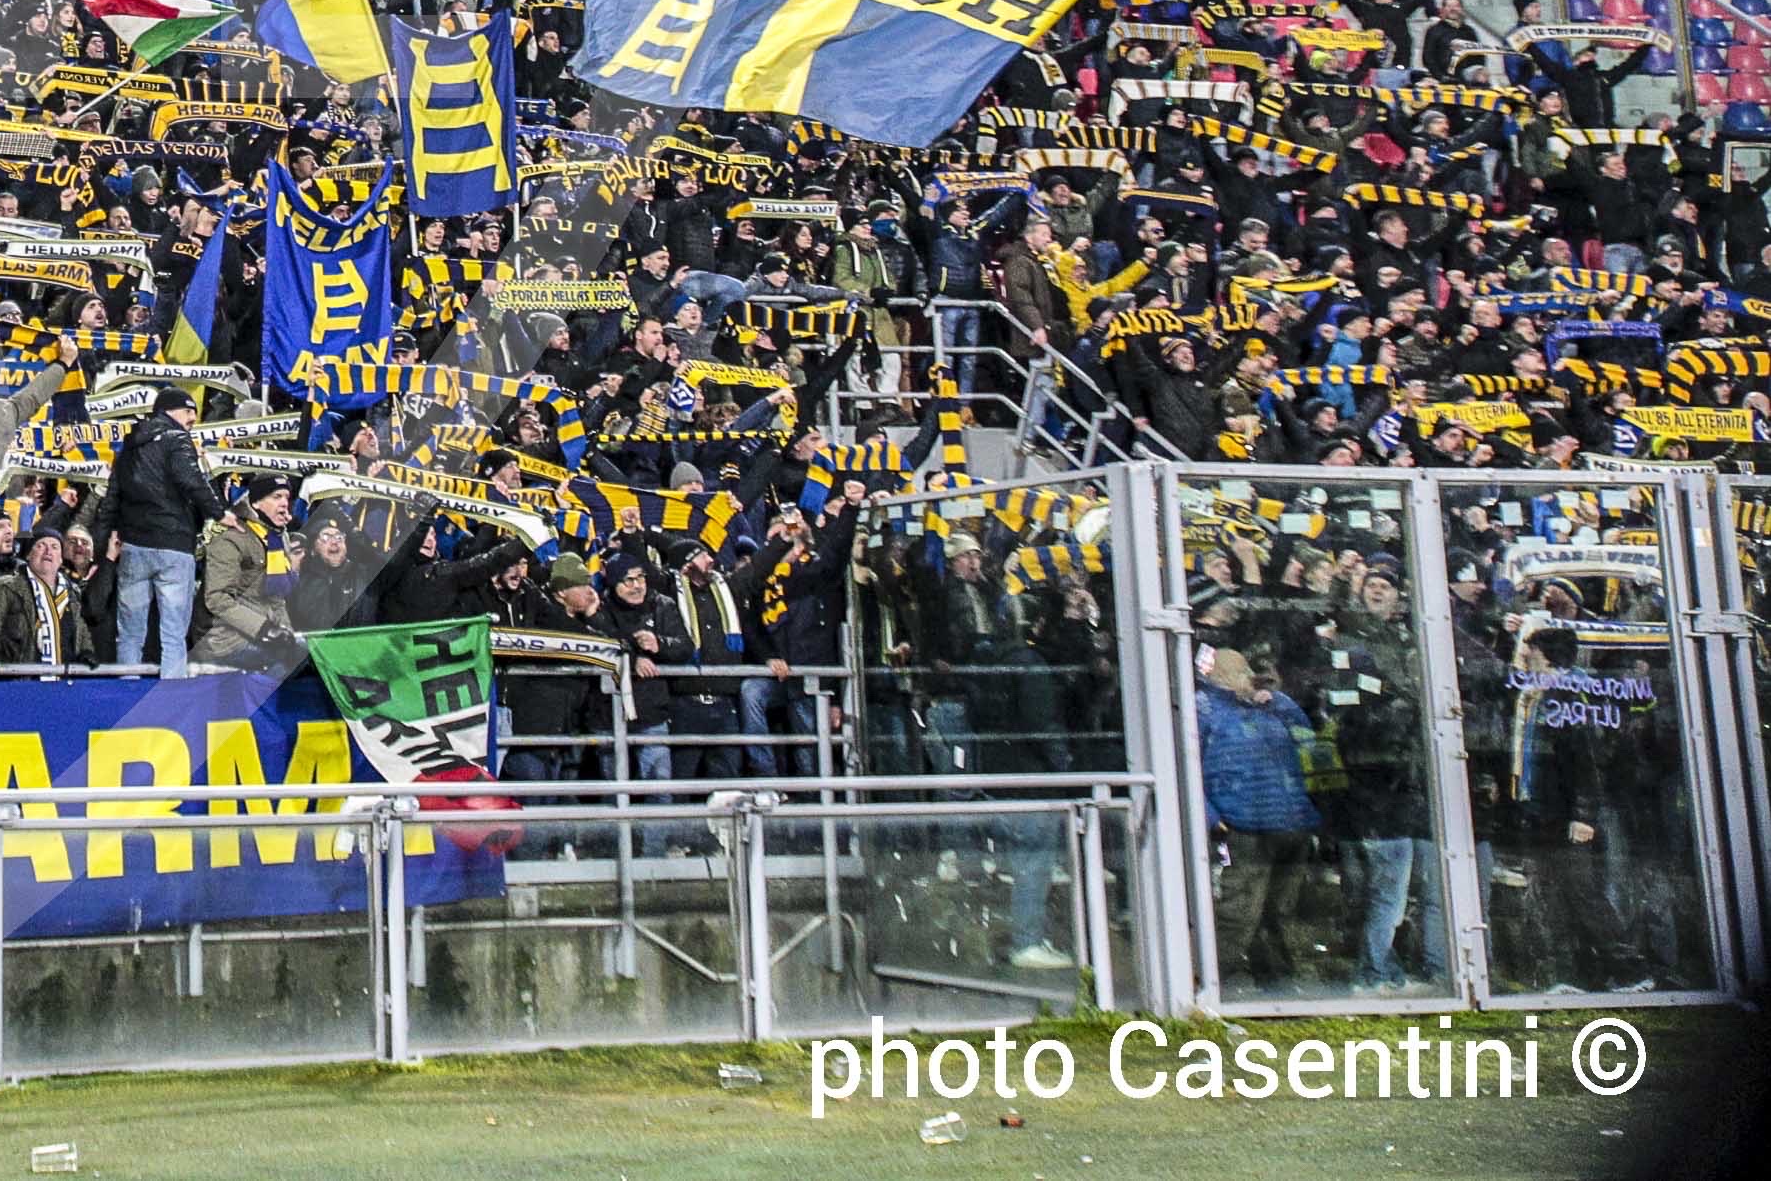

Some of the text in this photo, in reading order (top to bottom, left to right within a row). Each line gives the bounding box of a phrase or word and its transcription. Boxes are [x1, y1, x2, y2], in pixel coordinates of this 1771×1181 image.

[178, 103, 287, 124] HELLAS ARM
[25, 244, 90, 257] HELLAS
[100, 245, 143, 257] ARMY
[511, 288, 630, 303] FORZA HELLAS VERON
[116, 365, 234, 382] HELLAS ARMY
[112, 390, 149, 408] ARMY
[257, 420, 301, 434] ARM
[8, 454, 103, 477] HELLAS ARMY
[222, 454, 290, 470] HELLAS
[521, 458, 564, 478] VERON
[341, 478, 416, 500] HELLA
[387, 464, 488, 499] VERONA
[492, 635, 546, 652] LAS
